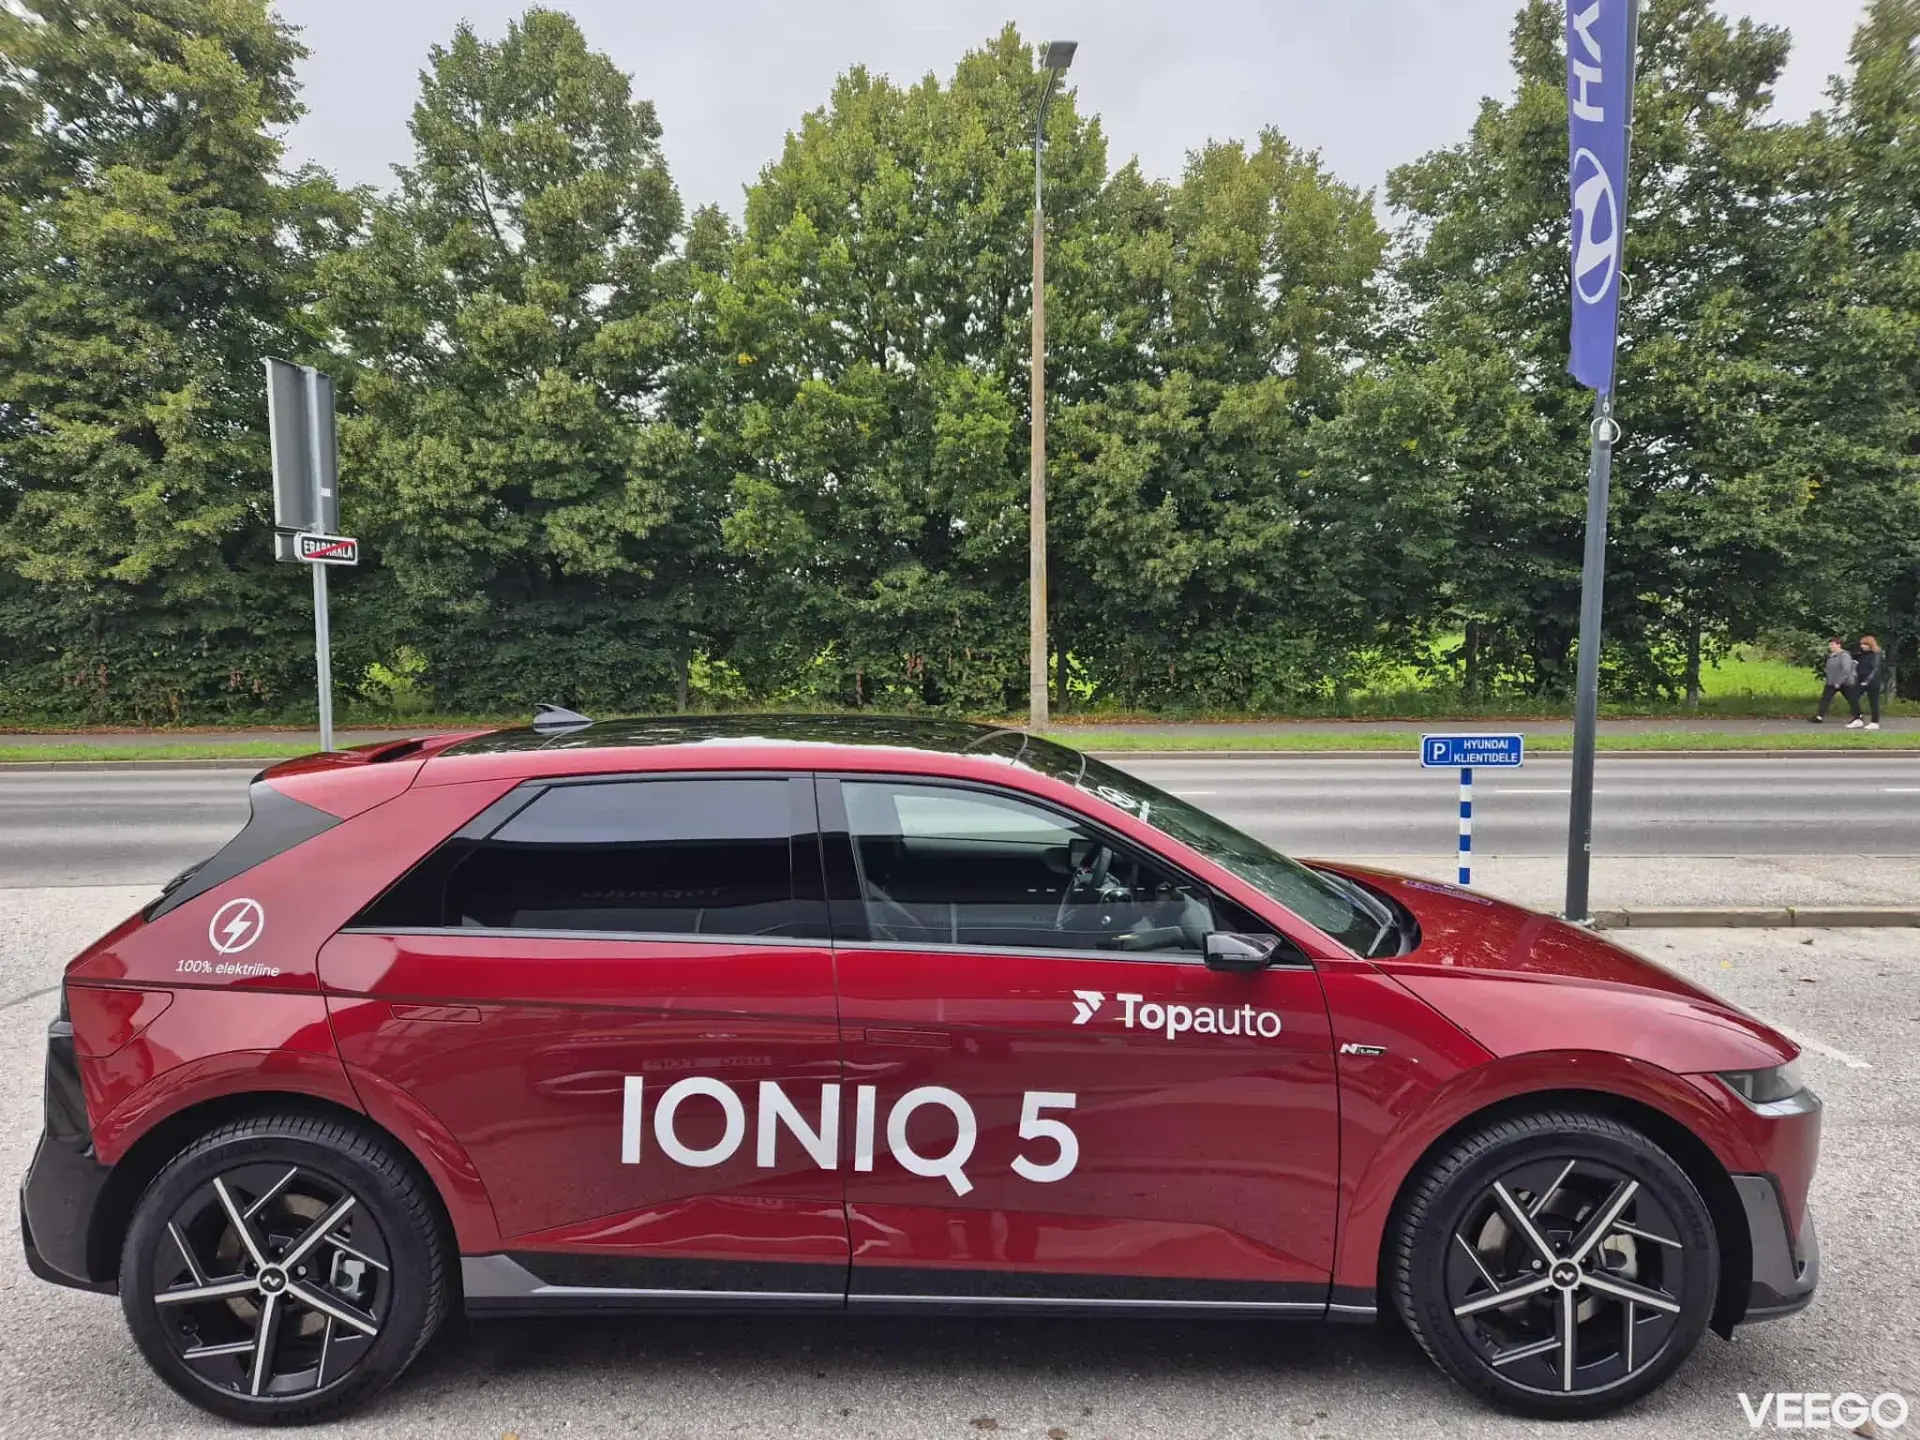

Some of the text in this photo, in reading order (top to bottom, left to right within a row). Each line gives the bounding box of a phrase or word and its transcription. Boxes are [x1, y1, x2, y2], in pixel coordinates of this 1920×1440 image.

[1433, 742, 1446, 761] P
[1463, 739, 1509, 750] HYUNDAI
[1453, 752, 1518, 763] KLIENTIDELE
[175, 959, 280, 978] 100% elektriline
[1116, 993, 1282, 1040] Topauto
[621, 1075, 1080, 1197] IONIQ 5
